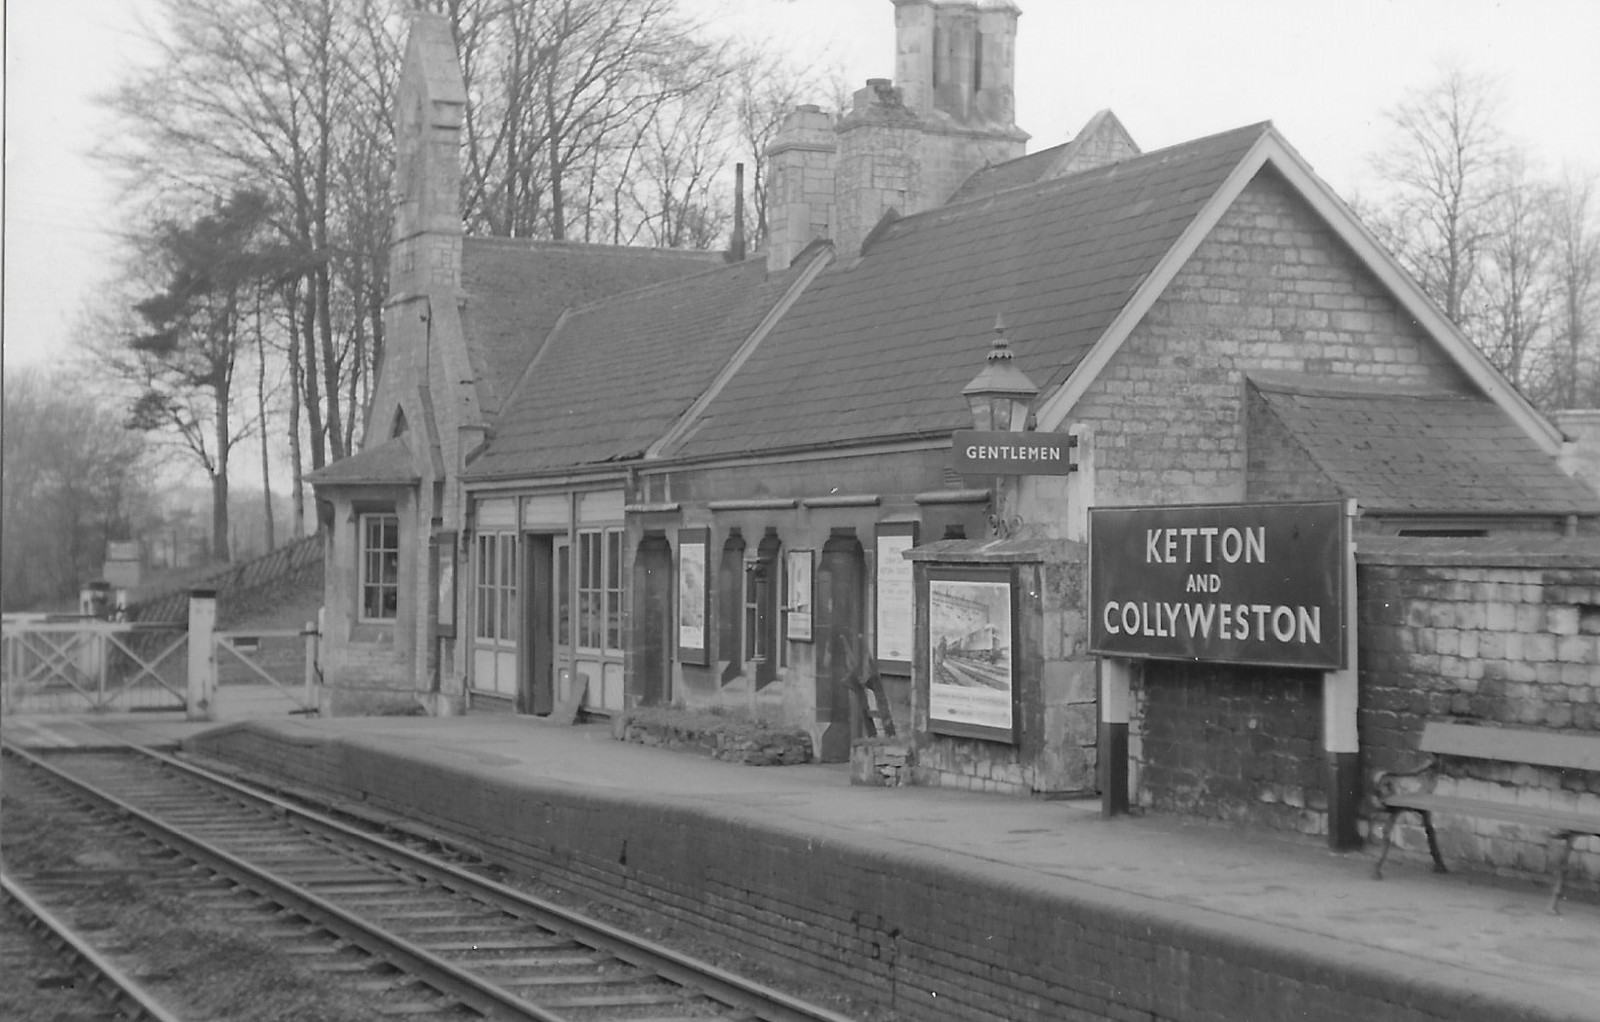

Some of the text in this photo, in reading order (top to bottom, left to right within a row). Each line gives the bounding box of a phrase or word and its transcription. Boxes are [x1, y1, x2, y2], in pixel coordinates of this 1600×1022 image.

[965, 445, 1062, 462] GENTLEMEN
[1145, 526, 1267, 565] KETTON
[1186, 573, 1222, 594] AND
[1103, 600, 1322, 645] COLLYWESTON
